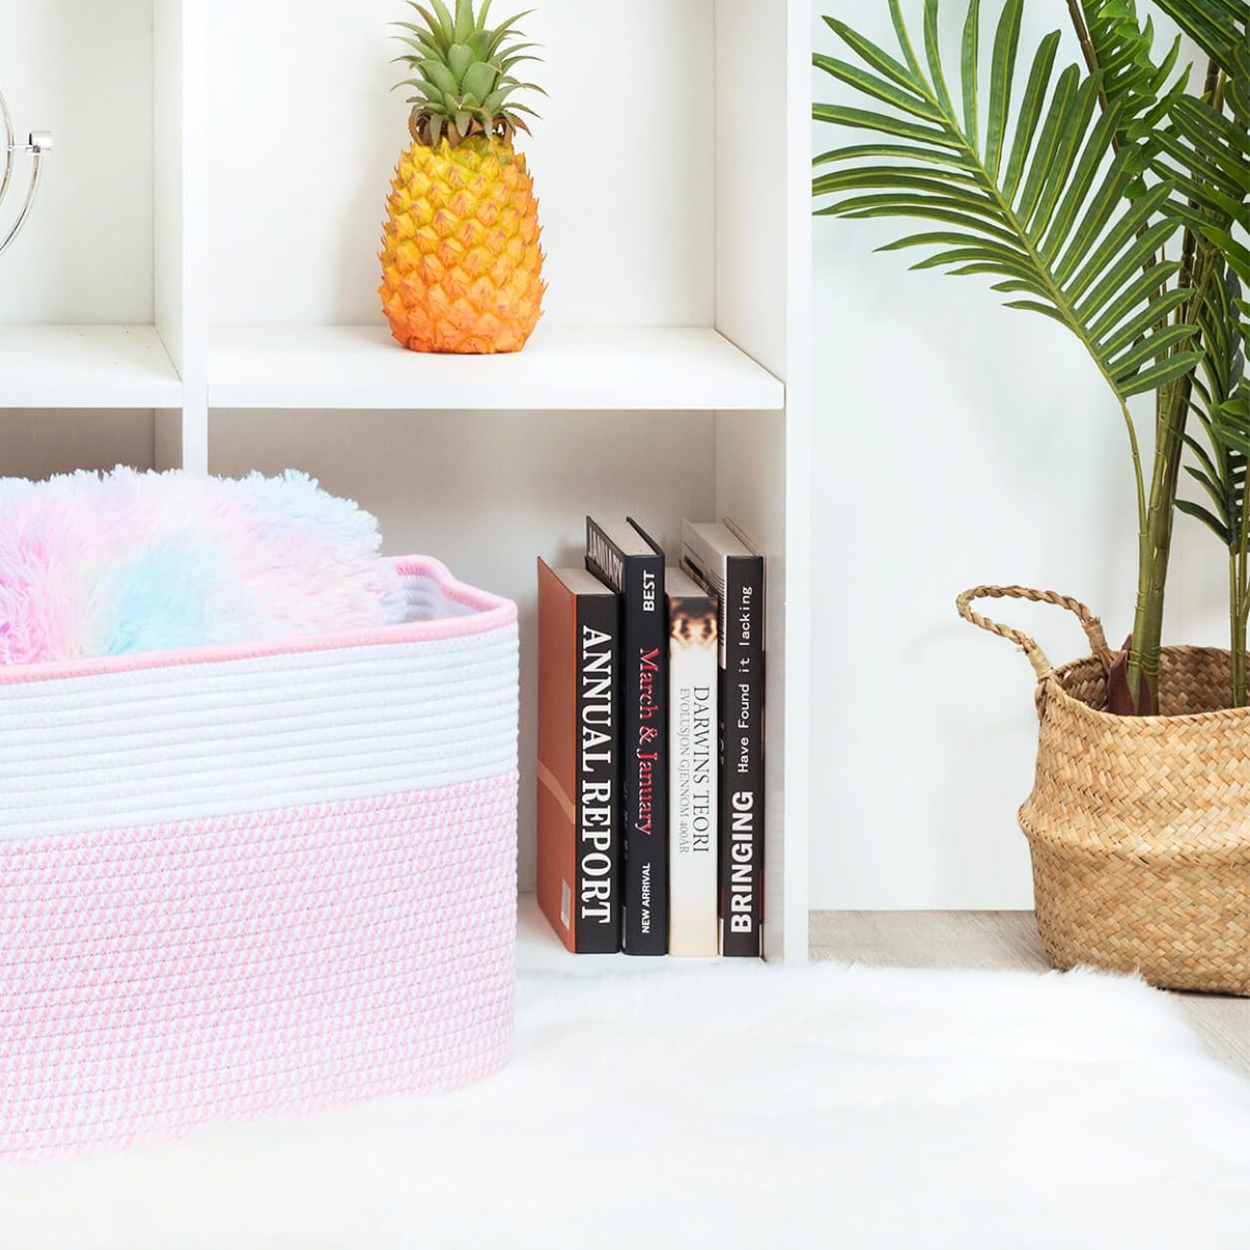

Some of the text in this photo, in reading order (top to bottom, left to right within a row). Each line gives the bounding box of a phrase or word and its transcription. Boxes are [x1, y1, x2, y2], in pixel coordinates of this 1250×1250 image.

[643, 570, 655, 611] BEST
[581, 626, 612, 923] ANNUAL REPORT
[634, 648, 659, 835] March & January
[677, 688, 690, 755] EVOLUSJON
[693, 686, 710, 853] DARWINS TEORI
[731, 586, 754, 932] BRINGING Have Found it lacking
[677, 758, 690, 818] GJENNOM
[641, 863, 651, 933] NEW ARRIVAL
